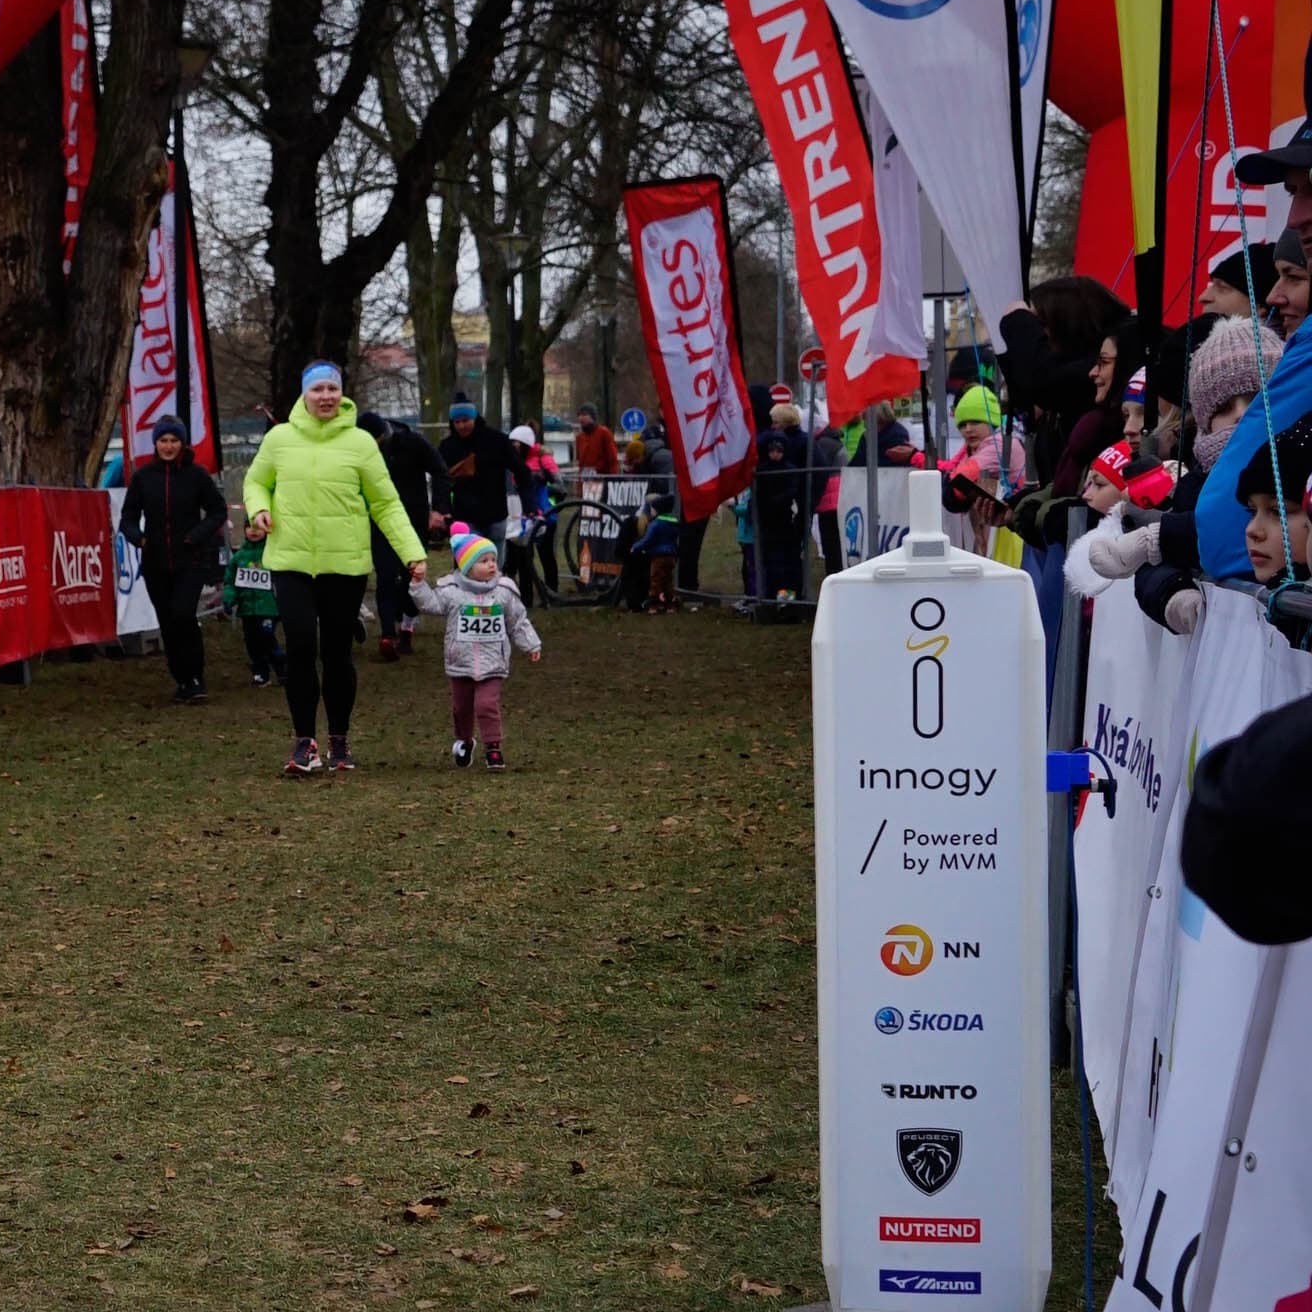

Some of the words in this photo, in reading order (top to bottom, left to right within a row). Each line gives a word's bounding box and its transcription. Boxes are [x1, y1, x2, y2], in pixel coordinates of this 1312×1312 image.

[661, 239, 727, 464] Nartes
[238, 569, 269, 584] 3100
[459, 617, 502, 634] 3426
[859, 759, 997, 797] innogy
[903, 828, 997, 846] Powered
[904, 853, 929, 875] by
[939, 853, 997, 870] MVM
[943, 942, 980, 958] NN
[908, 1010, 984, 1031] ŠKODA
[899, 1084, 978, 1100] RUNTO
[903, 1133, 956, 1141] PEUGEOT
[885, 1222, 977, 1238] NUTREND
